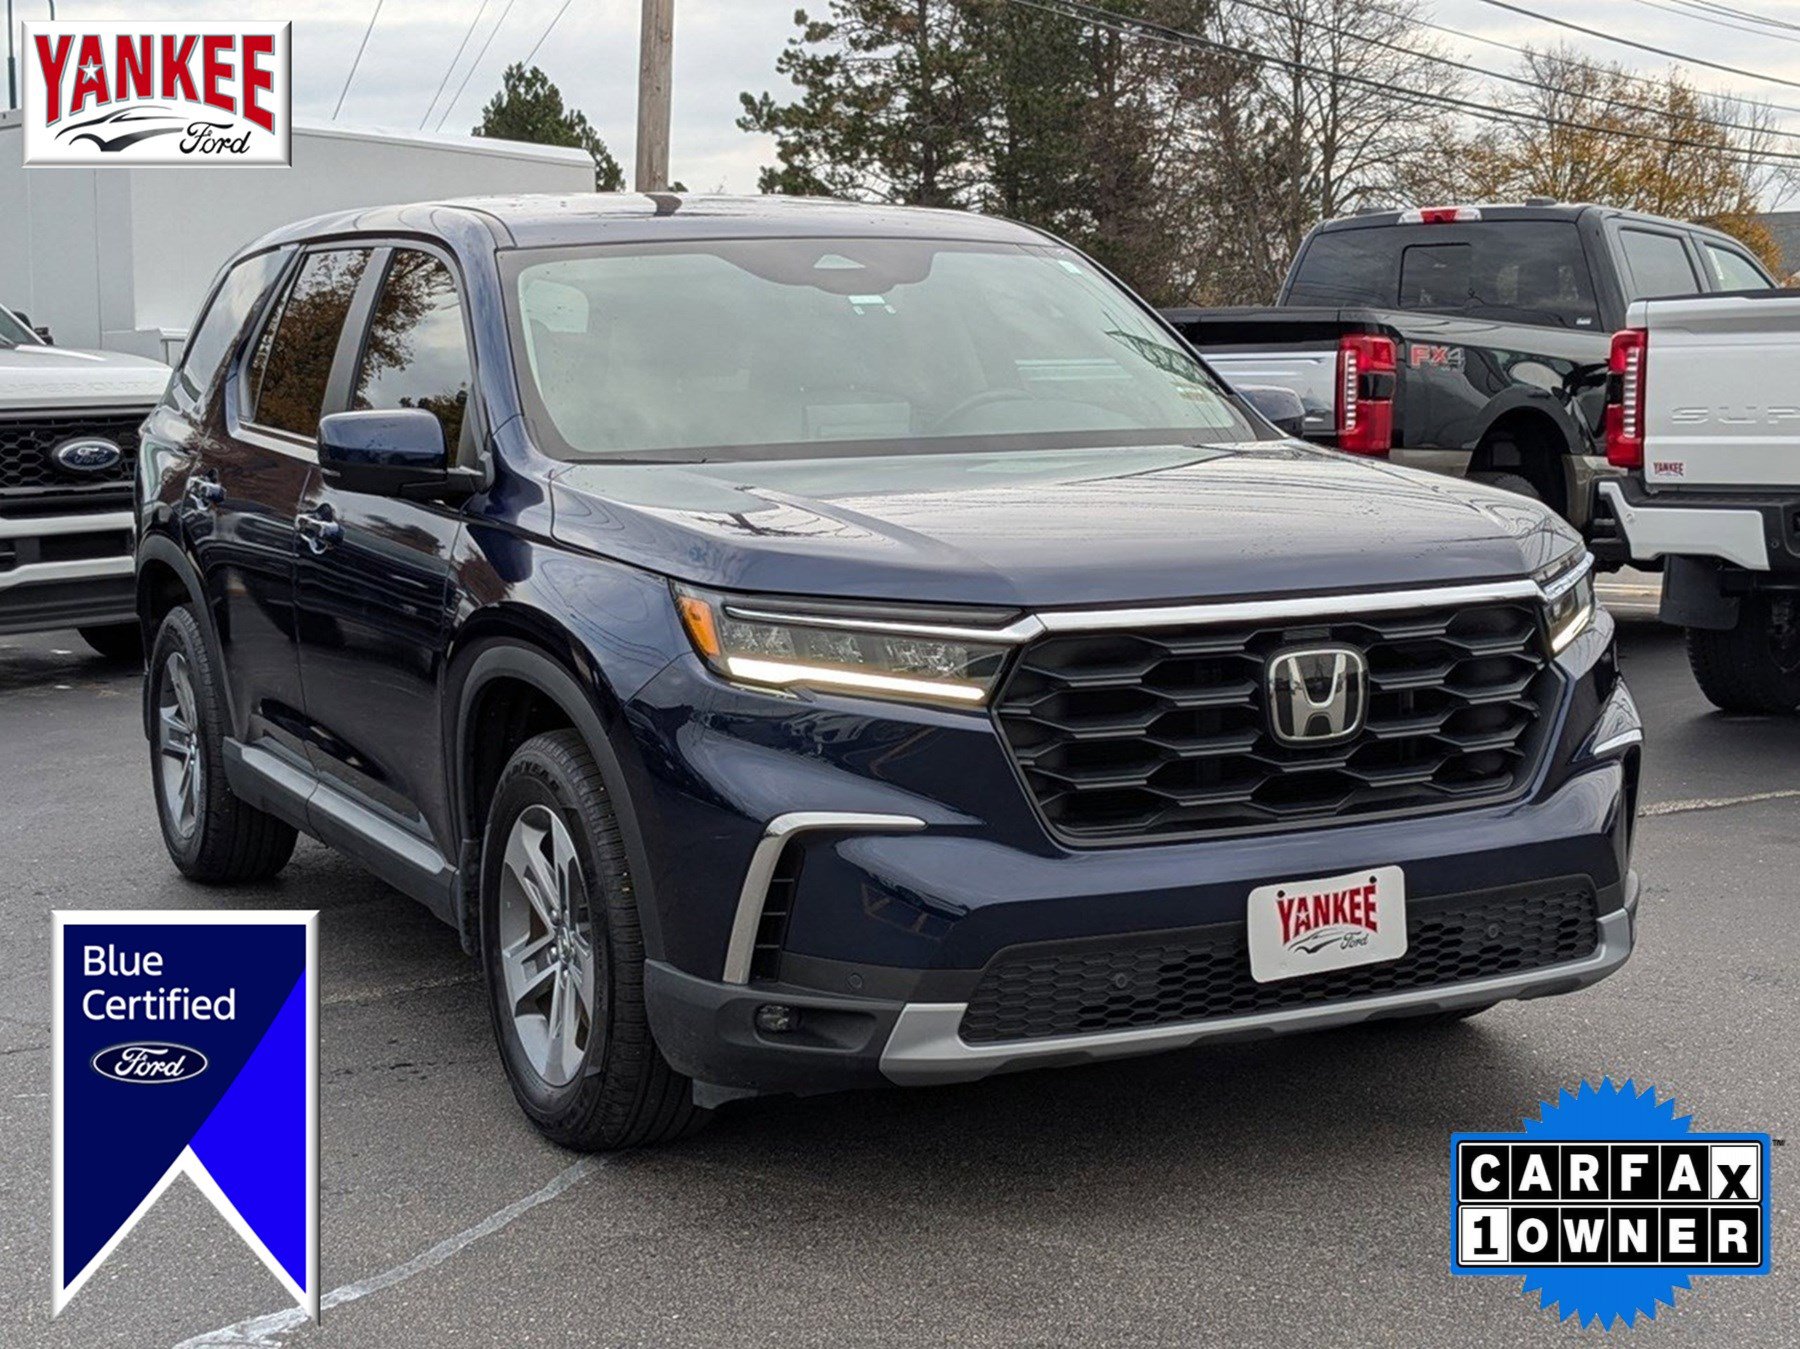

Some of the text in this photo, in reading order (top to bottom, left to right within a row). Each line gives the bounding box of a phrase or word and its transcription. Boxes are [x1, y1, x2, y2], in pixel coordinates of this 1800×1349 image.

[1410, 344, 1466, 372] FX4
[1653, 461, 1685, 477] YANKEE
[1277, 884, 1378, 946] YANKEE
[1340, 931, 1370, 950] Ford
